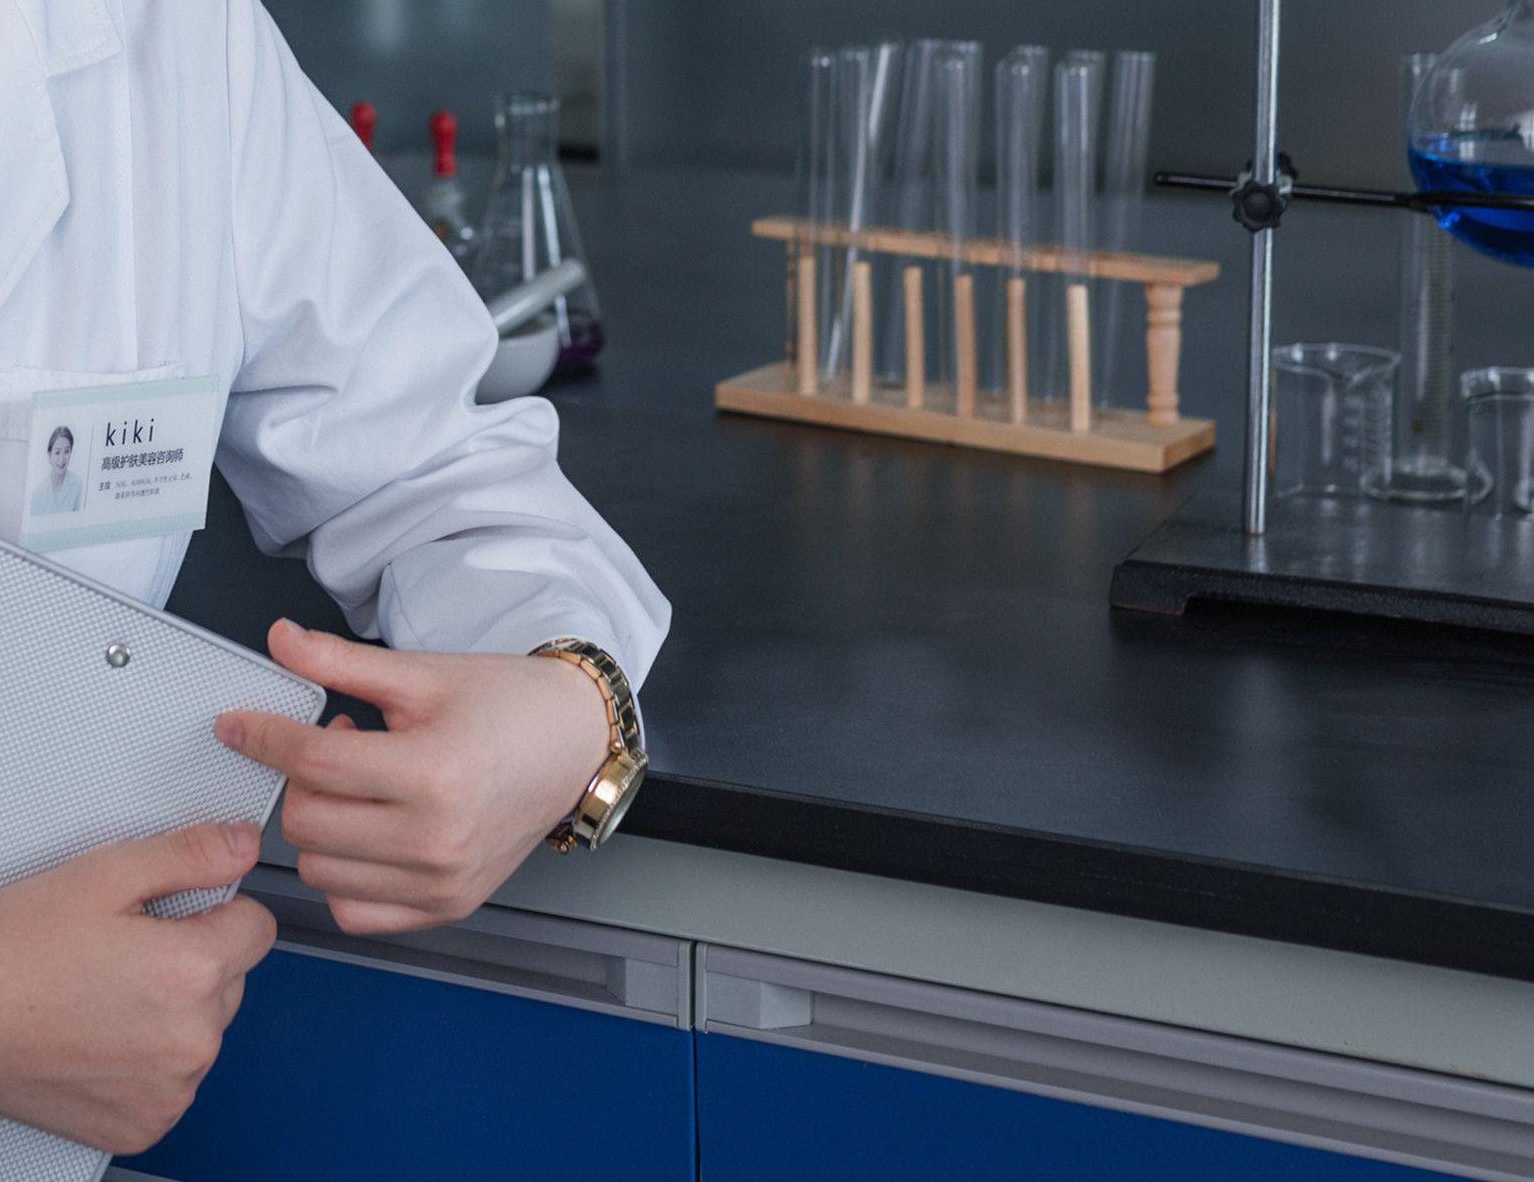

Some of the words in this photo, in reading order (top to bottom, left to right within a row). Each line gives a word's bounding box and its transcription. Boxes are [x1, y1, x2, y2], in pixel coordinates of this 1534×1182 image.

[105, 418, 154, 446] kiki
[101, 448, 184, 471] 高级护肤美容咨询师
